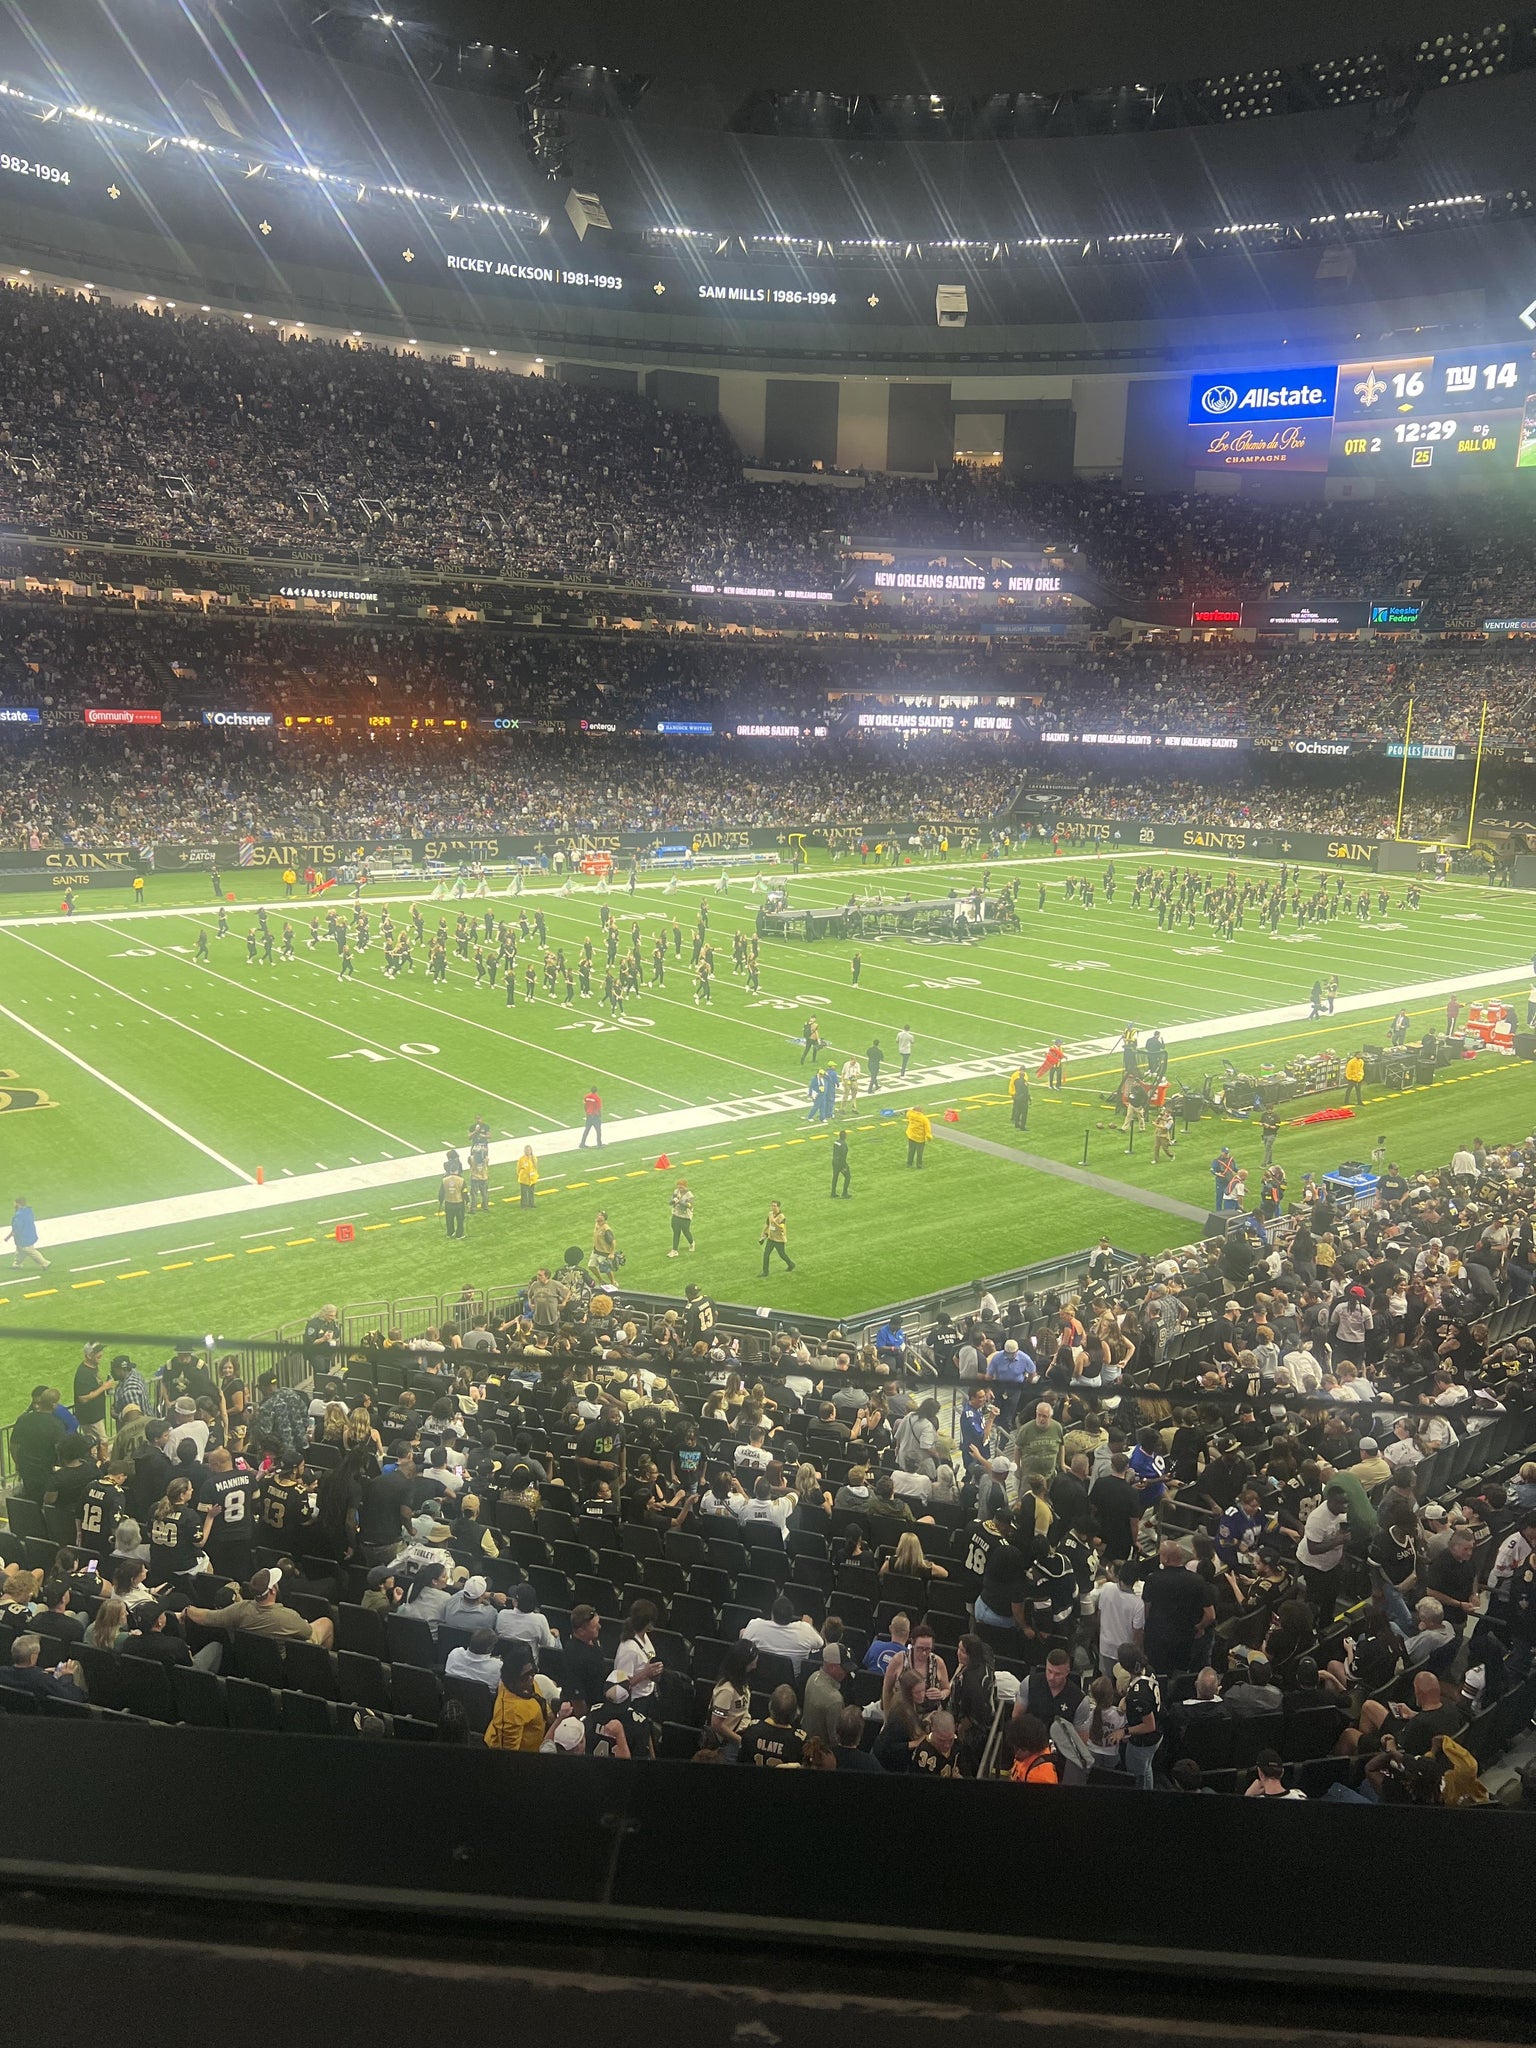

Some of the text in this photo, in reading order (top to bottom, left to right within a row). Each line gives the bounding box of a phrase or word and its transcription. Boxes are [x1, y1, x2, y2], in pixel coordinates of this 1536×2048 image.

[446, 255, 623, 291] RICKEY JACKSON 1981-1993
[698, 285, 837, 306] SAM MILLS 1986-1994
[1482, 362, 1518, 390] 14
[1391, 371, 1425, 398] 16
[1394, 420, 1457, 443] 12:29
[1344, 438, 1381, 456] QTR 2
[1458, 438, 1497, 453] BALL ON
[1225, 454, 1287, 463] CHAMPAGNE
[1415, 451, 1430, 464] 25
[50, 529, 89, 540] SAINTS
[135, 537, 172, 548] SAINTS
[215, 544, 250, 556] SAINTS
[291, 552, 325, 562] SAINTS
[434, 563, 465, 574] SAINTS
[500, 568, 529, 579] SAINTS
[563, 574, 592, 584] SAINTS
[624, 578, 652, 588] SAINTS
[875, 572, 986, 590] NEW ORLEANS SAINTS
[1008, 577, 1061, 592] NEW ORLE
[279, 587, 378, 601] CAESARS SUPERDOME
[1195, 609, 1240, 621] verizon
[1389, 607, 1419, 615] Keesler
[1389, 614, 1418, 623] Federal
[1444, 620, 1476, 628] SAINTS
[42, 710, 80, 720] SAINTS
[88, 710, 134, 723] Community
[214, 712, 271, 725] Ochsner
[858, 714, 954, 728] NEW ORLEANS SAINTS
[494, 718, 519, 729] COX
[589, 723, 616, 732] entergy
[974, 716, 995, 728] NEW
[737, 725, 800, 737] ORLEANS SAINTS
[1046, 733, 1069, 742] SAINTS
[1082, 734, 1151, 745] NEW ORLEANS SAINTS
[1165, 736, 1237, 748] NEW ORLEANS SAINTS
[1254, 738, 1284, 747] SAINTS
[1296, 741, 1349, 756] Ochsner
[1423, 747, 1454, 759] HEALTH
[1056, 822, 1110, 839] SAINTS
[692, 831, 750, 847] SAINTS
[1183, 830, 1246, 849] SAINTS
[189, 852, 216, 861] CATCH
[53, 875, 90, 886] SAINTS
[1057, 960, 1111, 972] 50
[921, 976, 982, 989] 40
[756, 994, 832, 1009] 30
[572, 1016, 656, 1033] 20
[348, 1042, 441, 1063] 10
[698, 1307, 714, 1332] 13
[388, 1410, 408, 1421] SAINTS
[215, 1475, 250, 1492] MANNING
[224, 1489, 245, 1523] 8
[81, 1503, 102, 1533] 12
[263, 1498, 286, 1528] 13
[151, 1519, 178, 1548] 80
[971, 1533, 990, 1552] RATTLER
[1507, 1540, 1517, 1549] 9
[414, 1548, 434, 1560] TURLEY
[965, 1543, 987, 1575] 18
[756, 1738, 785, 1755] OLAVE
[918, 1750, 937, 1771] 34
